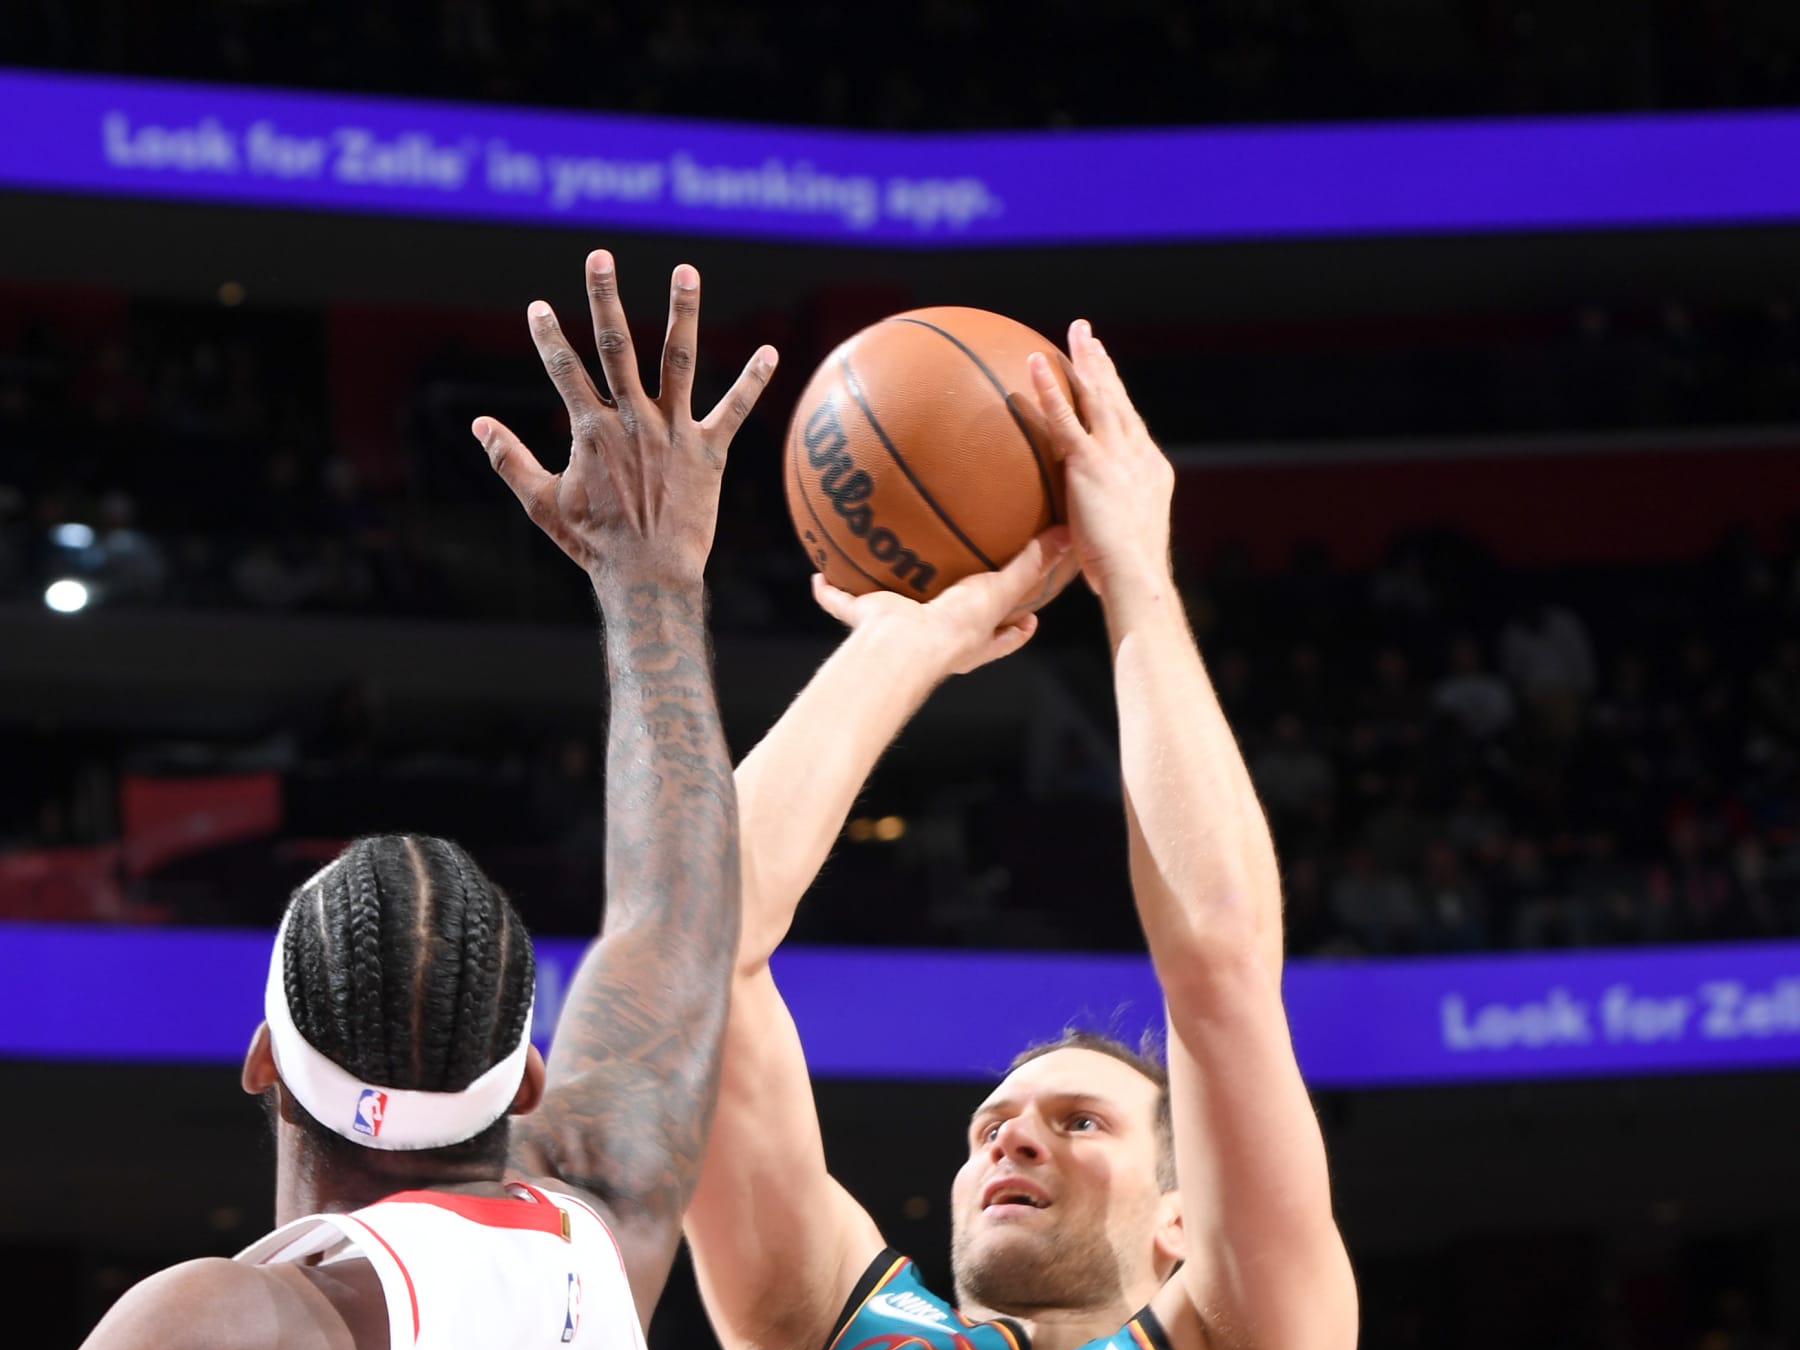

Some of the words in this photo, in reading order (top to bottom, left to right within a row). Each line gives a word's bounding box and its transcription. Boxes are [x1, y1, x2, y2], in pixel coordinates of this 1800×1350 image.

[103, 112, 236, 173] Look
[247, 122, 324, 178] for
[486, 139, 542, 192] in
[549, 156, 662, 209] your
[671, 151, 877, 230] banking
[804, 395, 937, 593] Wilson
[1442, 985, 1592, 1050] Look
[1602, 982, 1692, 1043] for
[889, 1291, 949, 1322] NIKE
